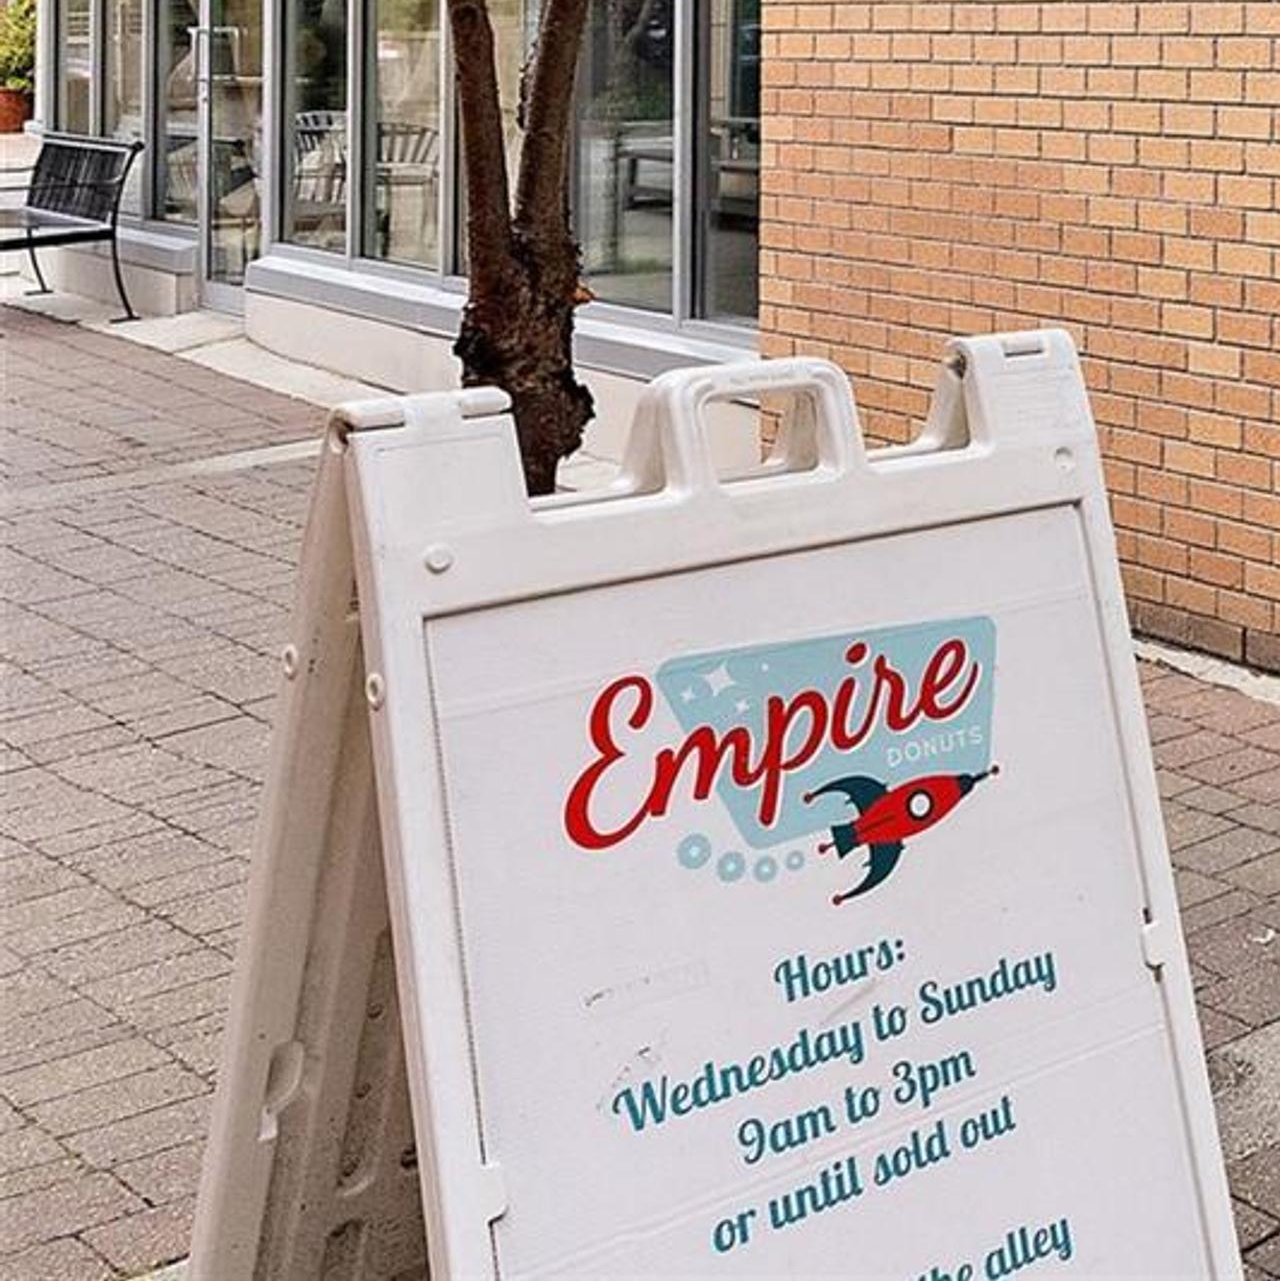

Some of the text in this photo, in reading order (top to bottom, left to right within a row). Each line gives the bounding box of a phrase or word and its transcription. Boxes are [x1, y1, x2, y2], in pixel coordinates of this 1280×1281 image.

[564, 638, 979, 851] Empire
[886, 724, 984, 769] DONUTS
[774, 940, 903, 1002] Hours:
[612, 952, 1058, 1132] Wednesday to Sunday
[737, 1050, 977, 1166] 9am to 3pm
[712, 1096, 1016, 1254] or until sold out
[985, 1218, 1073, 1281] alley
